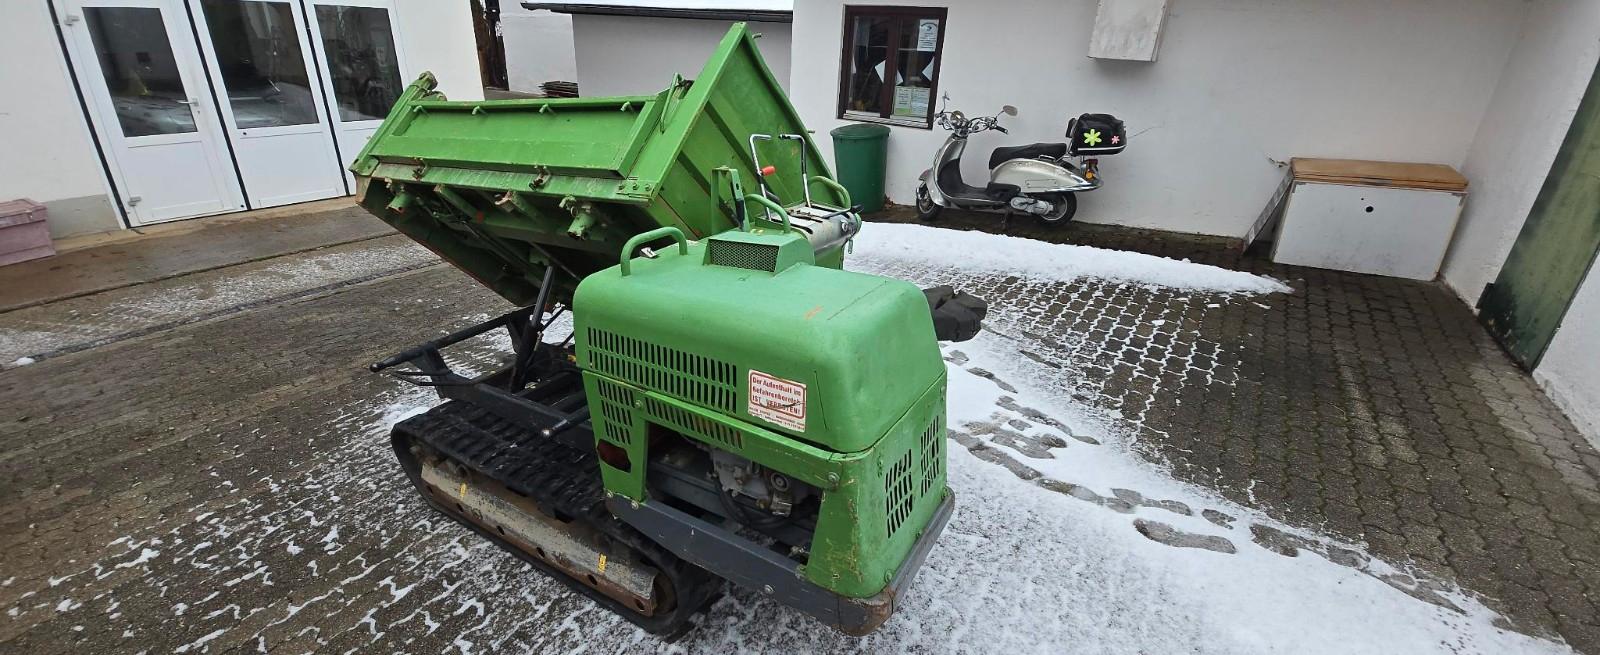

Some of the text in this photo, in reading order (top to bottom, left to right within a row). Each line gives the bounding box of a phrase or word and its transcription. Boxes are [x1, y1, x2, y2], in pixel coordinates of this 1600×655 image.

[753, 377, 801, 396] Der Aufenthalt im
